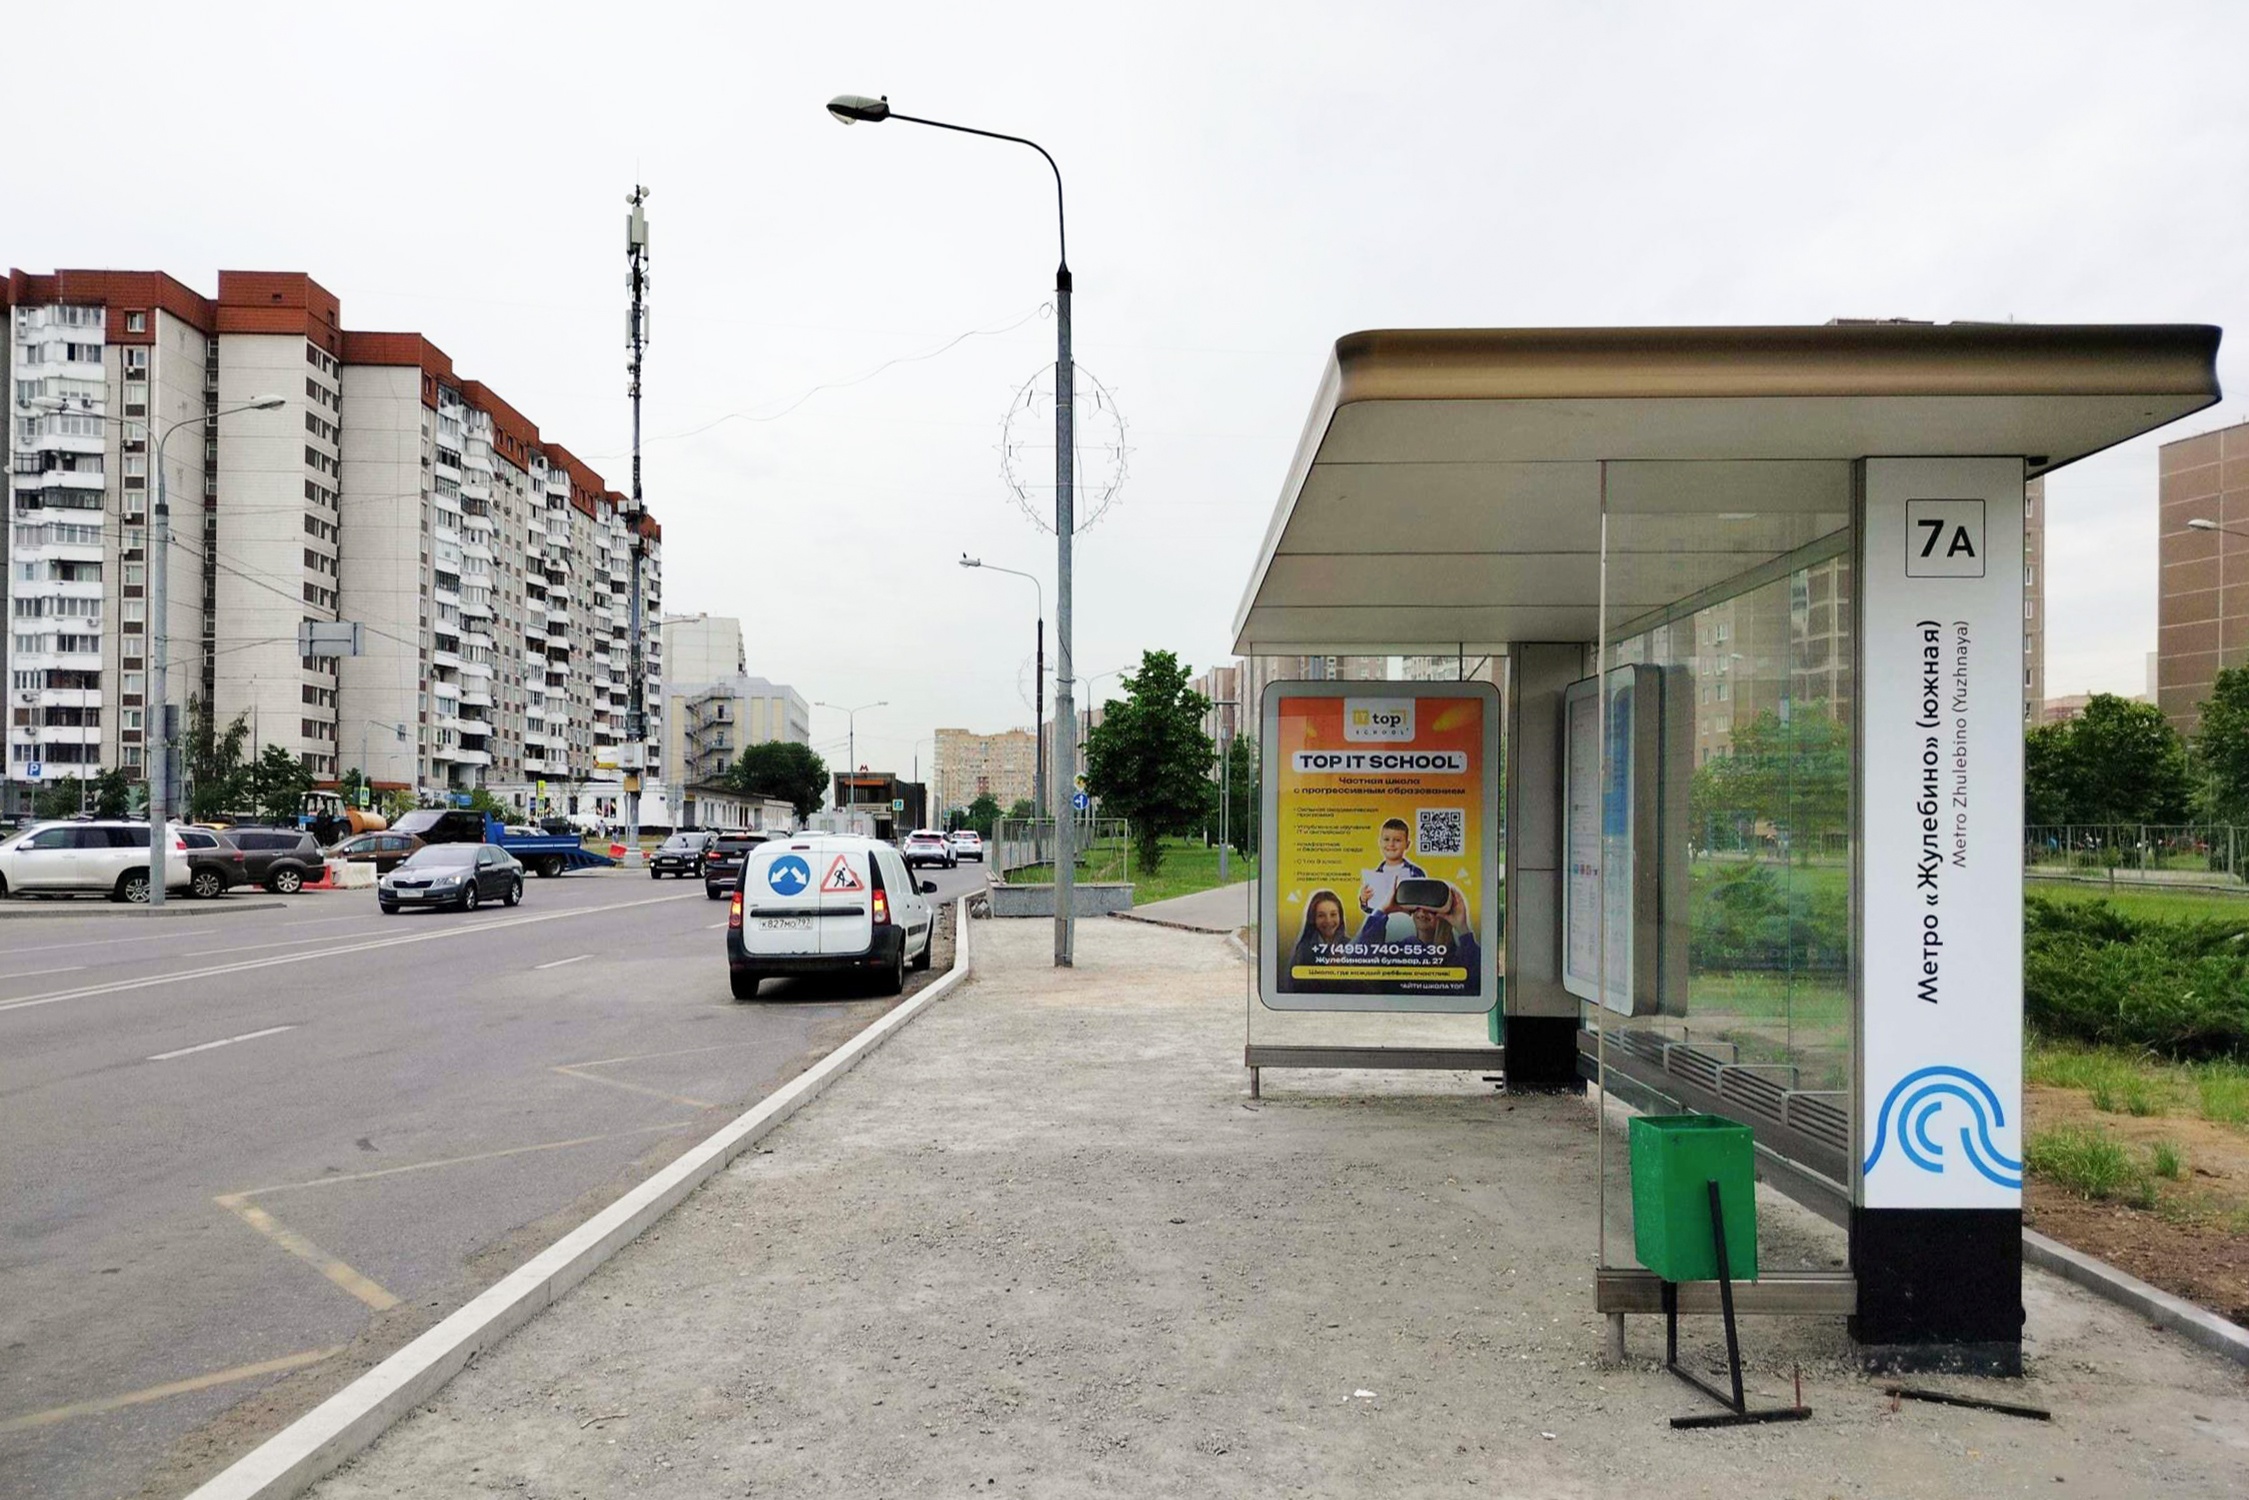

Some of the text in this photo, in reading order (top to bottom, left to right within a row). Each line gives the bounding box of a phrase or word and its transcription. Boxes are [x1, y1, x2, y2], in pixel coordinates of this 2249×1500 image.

[1917, 518, 1976, 558] 7А
[1372, 713, 1402, 727] top
[1951, 620, 1971, 868] Metro Zhulebino (Yuzhnaya)
[1300, 755, 1342, 769] TOP
[1346, 755, 1365, 769] IT
[1339, 777, 1420, 785] Частная школа
[1388, 787, 1466, 796] образованием
[1916, 620, 1943, 1004] Метро «Жулебино» (южная)
[1311, 944, 1447, 955] +7 (495) 740-55-30
